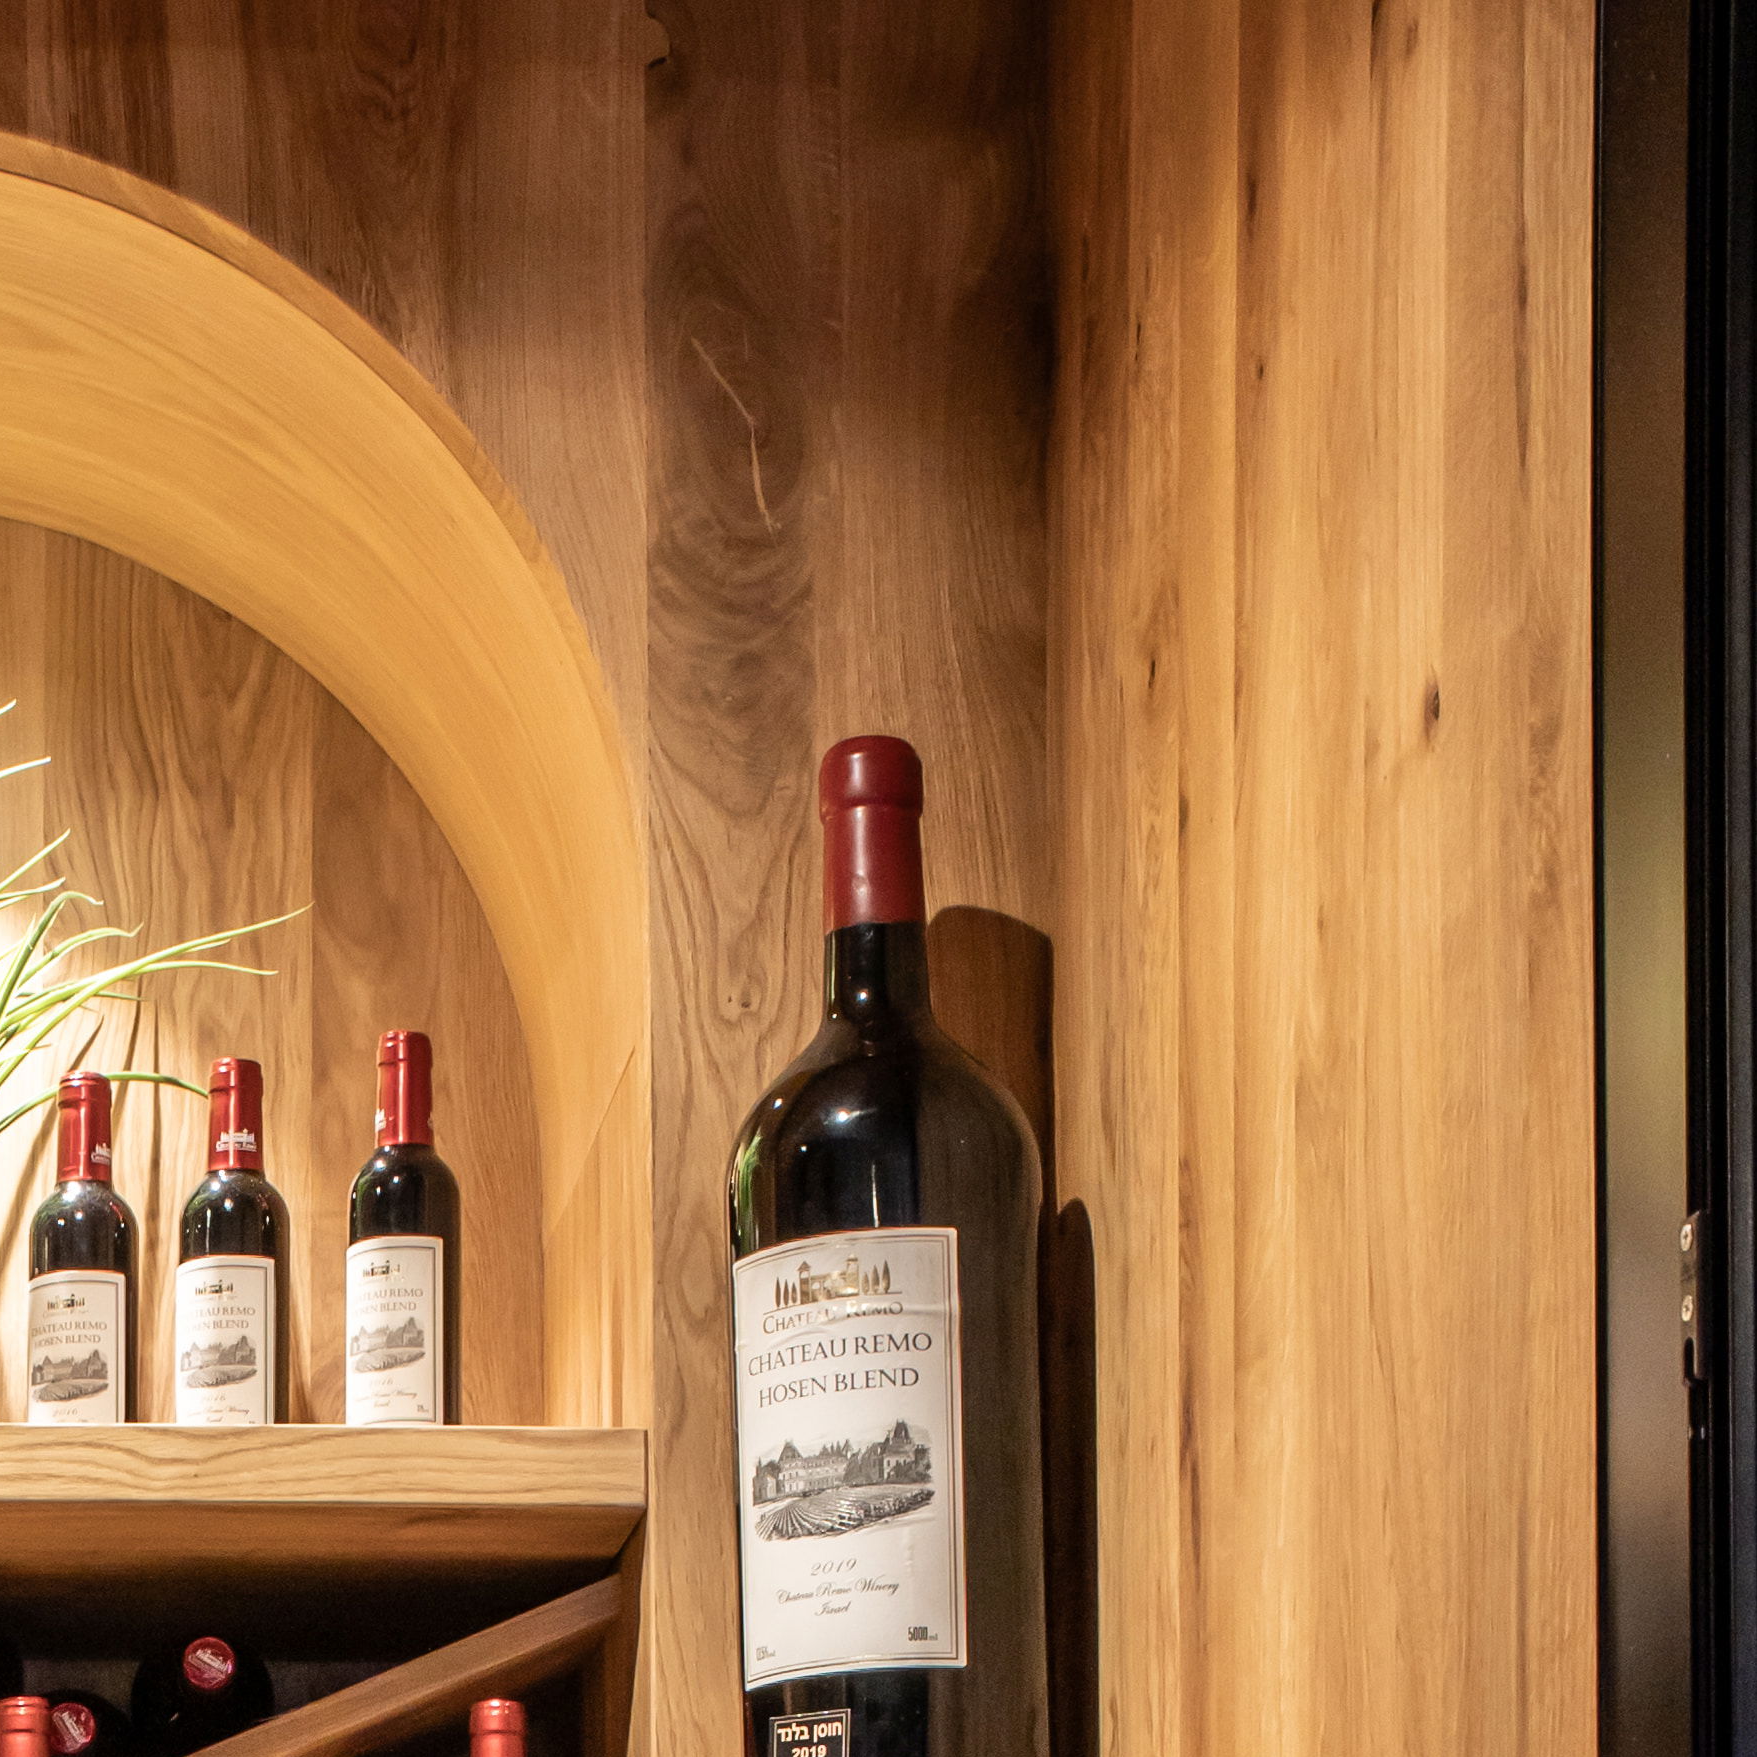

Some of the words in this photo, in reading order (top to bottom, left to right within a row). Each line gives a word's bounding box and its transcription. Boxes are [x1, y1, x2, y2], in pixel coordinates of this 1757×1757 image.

[389, 1288, 424, 1299] REMO
[380, 1302, 417, 1313] BLEND
[74, 1322, 108, 1331] REMO
[65, 1335, 101, 1345] BLEND
[748, 1337, 847, 1377] CHATEAU
[854, 1332, 932, 1355] REMO
[758, 1375, 827, 1408] HOSEN
[834, 1367, 919, 1392] BLEND
[810, 1558, 858, 1577] 2019
[777, 1723, 811, 1742] בלנד
[813, 1721, 843, 1743] חוסן
